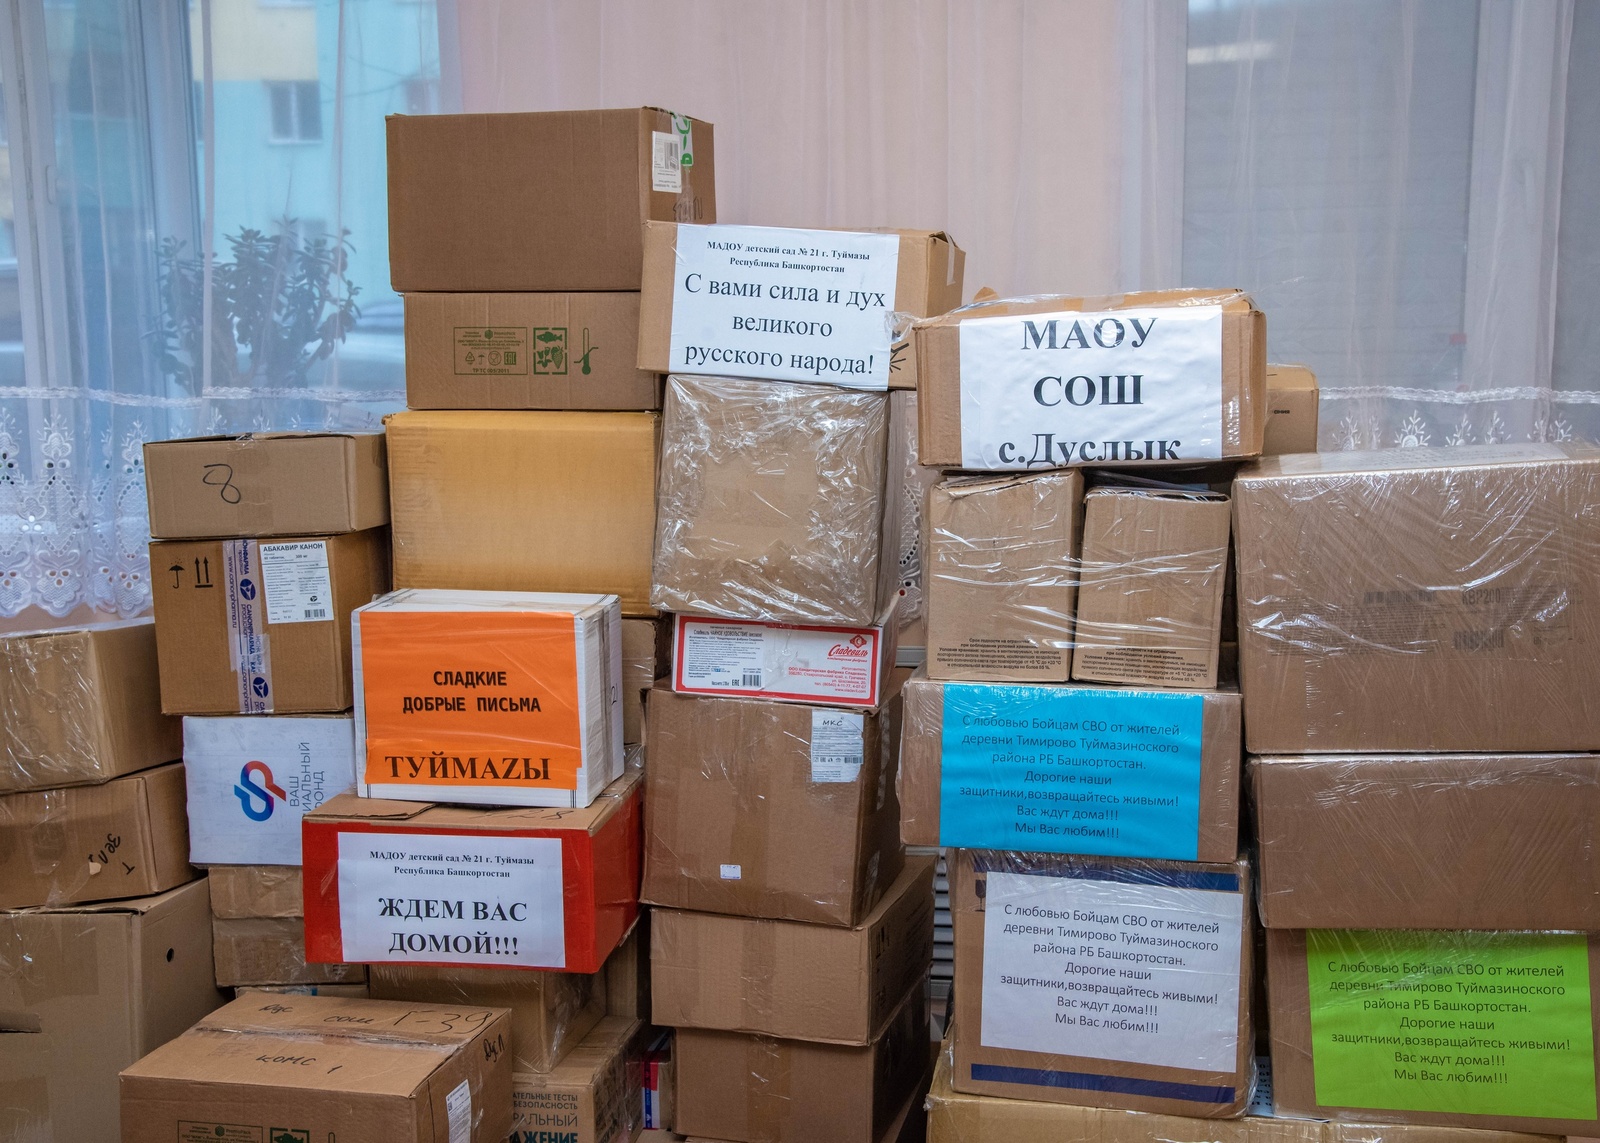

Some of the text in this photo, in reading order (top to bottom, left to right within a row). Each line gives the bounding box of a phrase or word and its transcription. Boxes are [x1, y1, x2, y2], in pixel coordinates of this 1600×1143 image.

[707, 241, 743, 252] МАДОУ
[745, 244, 780, 255] детский
[782, 246, 796, 256] сад
[798, 247, 808, 256] №
[810, 248, 819, 257] 21
[831, 249, 869, 261] Туймазы
[730, 257, 845, 274] Республика Башкортостан
[684, 273, 885, 311] С вами сила и дух
[732, 314, 832, 337] великого
[1020, 317, 1158, 350] МАОУ
[684, 345, 874, 376] русского народа!
[1034, 374, 1143, 407] СОШ
[998, 433, 1180, 469] с.Дуслык
[433, 671, 507, 688] СЛАДКИЕ
[403, 697, 541, 714] ДОБРЫЕ ПИСЬМА
[962, 715, 1180, 735] С любовью Бойцам СВО от жителей
[962, 735, 1178, 754] деревни Тимирово Туймазиноского
[992, 753, 1146, 770] района РБ Башкортостан.
[298, 742, 311, 811] ИАЛЬНЫЙ
[1024, 771, 1112, 785] Дорогие наши
[289, 776, 299, 807] ВАШ
[960, 786, 1178, 806] защитники,возвращайтесь живыми!
[1017, 805, 1118, 821] Вас ждут дома!!!
[1015, 822, 1120, 838] Мы Вас любим!!!
[370, 851, 406, 861] МАДОУ
[408, 852, 443, 863] детский
[446, 854, 460, 863] сад
[462, 854, 472, 863] №
[474, 854, 484, 863] 21
[495, 854, 534, 867] Туймазы
[394, 866, 510, 879] Республика Башкортостан
[378, 898, 527, 922] ЖДЕМ ВАС
[1004, 904, 1219, 934] С любовью Бойцам СВО от жителей
[388, 931, 518, 955] ДОМОЙ!!!
[1004, 924, 1218, 951] деревни Тимирово Туймазиноского
[1033, 942, 1186, 966] района РБ Башкортостан.
[1065, 962, 1152, 980] Дорогие наши
[1328, 961, 1564, 977] С любовью Бойцам СВО от жителей
[1001, 975, 1218, 1004] защитники,возвращайтесь живыми!
[1330, 981, 1565, 996] деревни Тимирово Туймазиноского
[1058, 996, 1158, 1016] Вас ждут дома!!!
[1363, 999, 1531, 1014] района РБ Башкортостан.
[1055, 1013, 1158, 1034] Мы Вас любим!!!
[1400, 1016, 1495, 1030] Дорогие наши
[1331, 1033, 1570, 1050] защитники,возвращайтесь живыми!
[1394, 1052, 1505, 1068] Вас ждут дома!!!
[1394, 1069, 1508, 1084] Мы Вас любим!!!
[514, 1101, 578, 1109] БЕЗОПАСНОСТЬ
[513, 1112, 578, 1127] РАЛЬНЫЙ
[510, 1131, 578, 1143] АЖЕНИЕ
